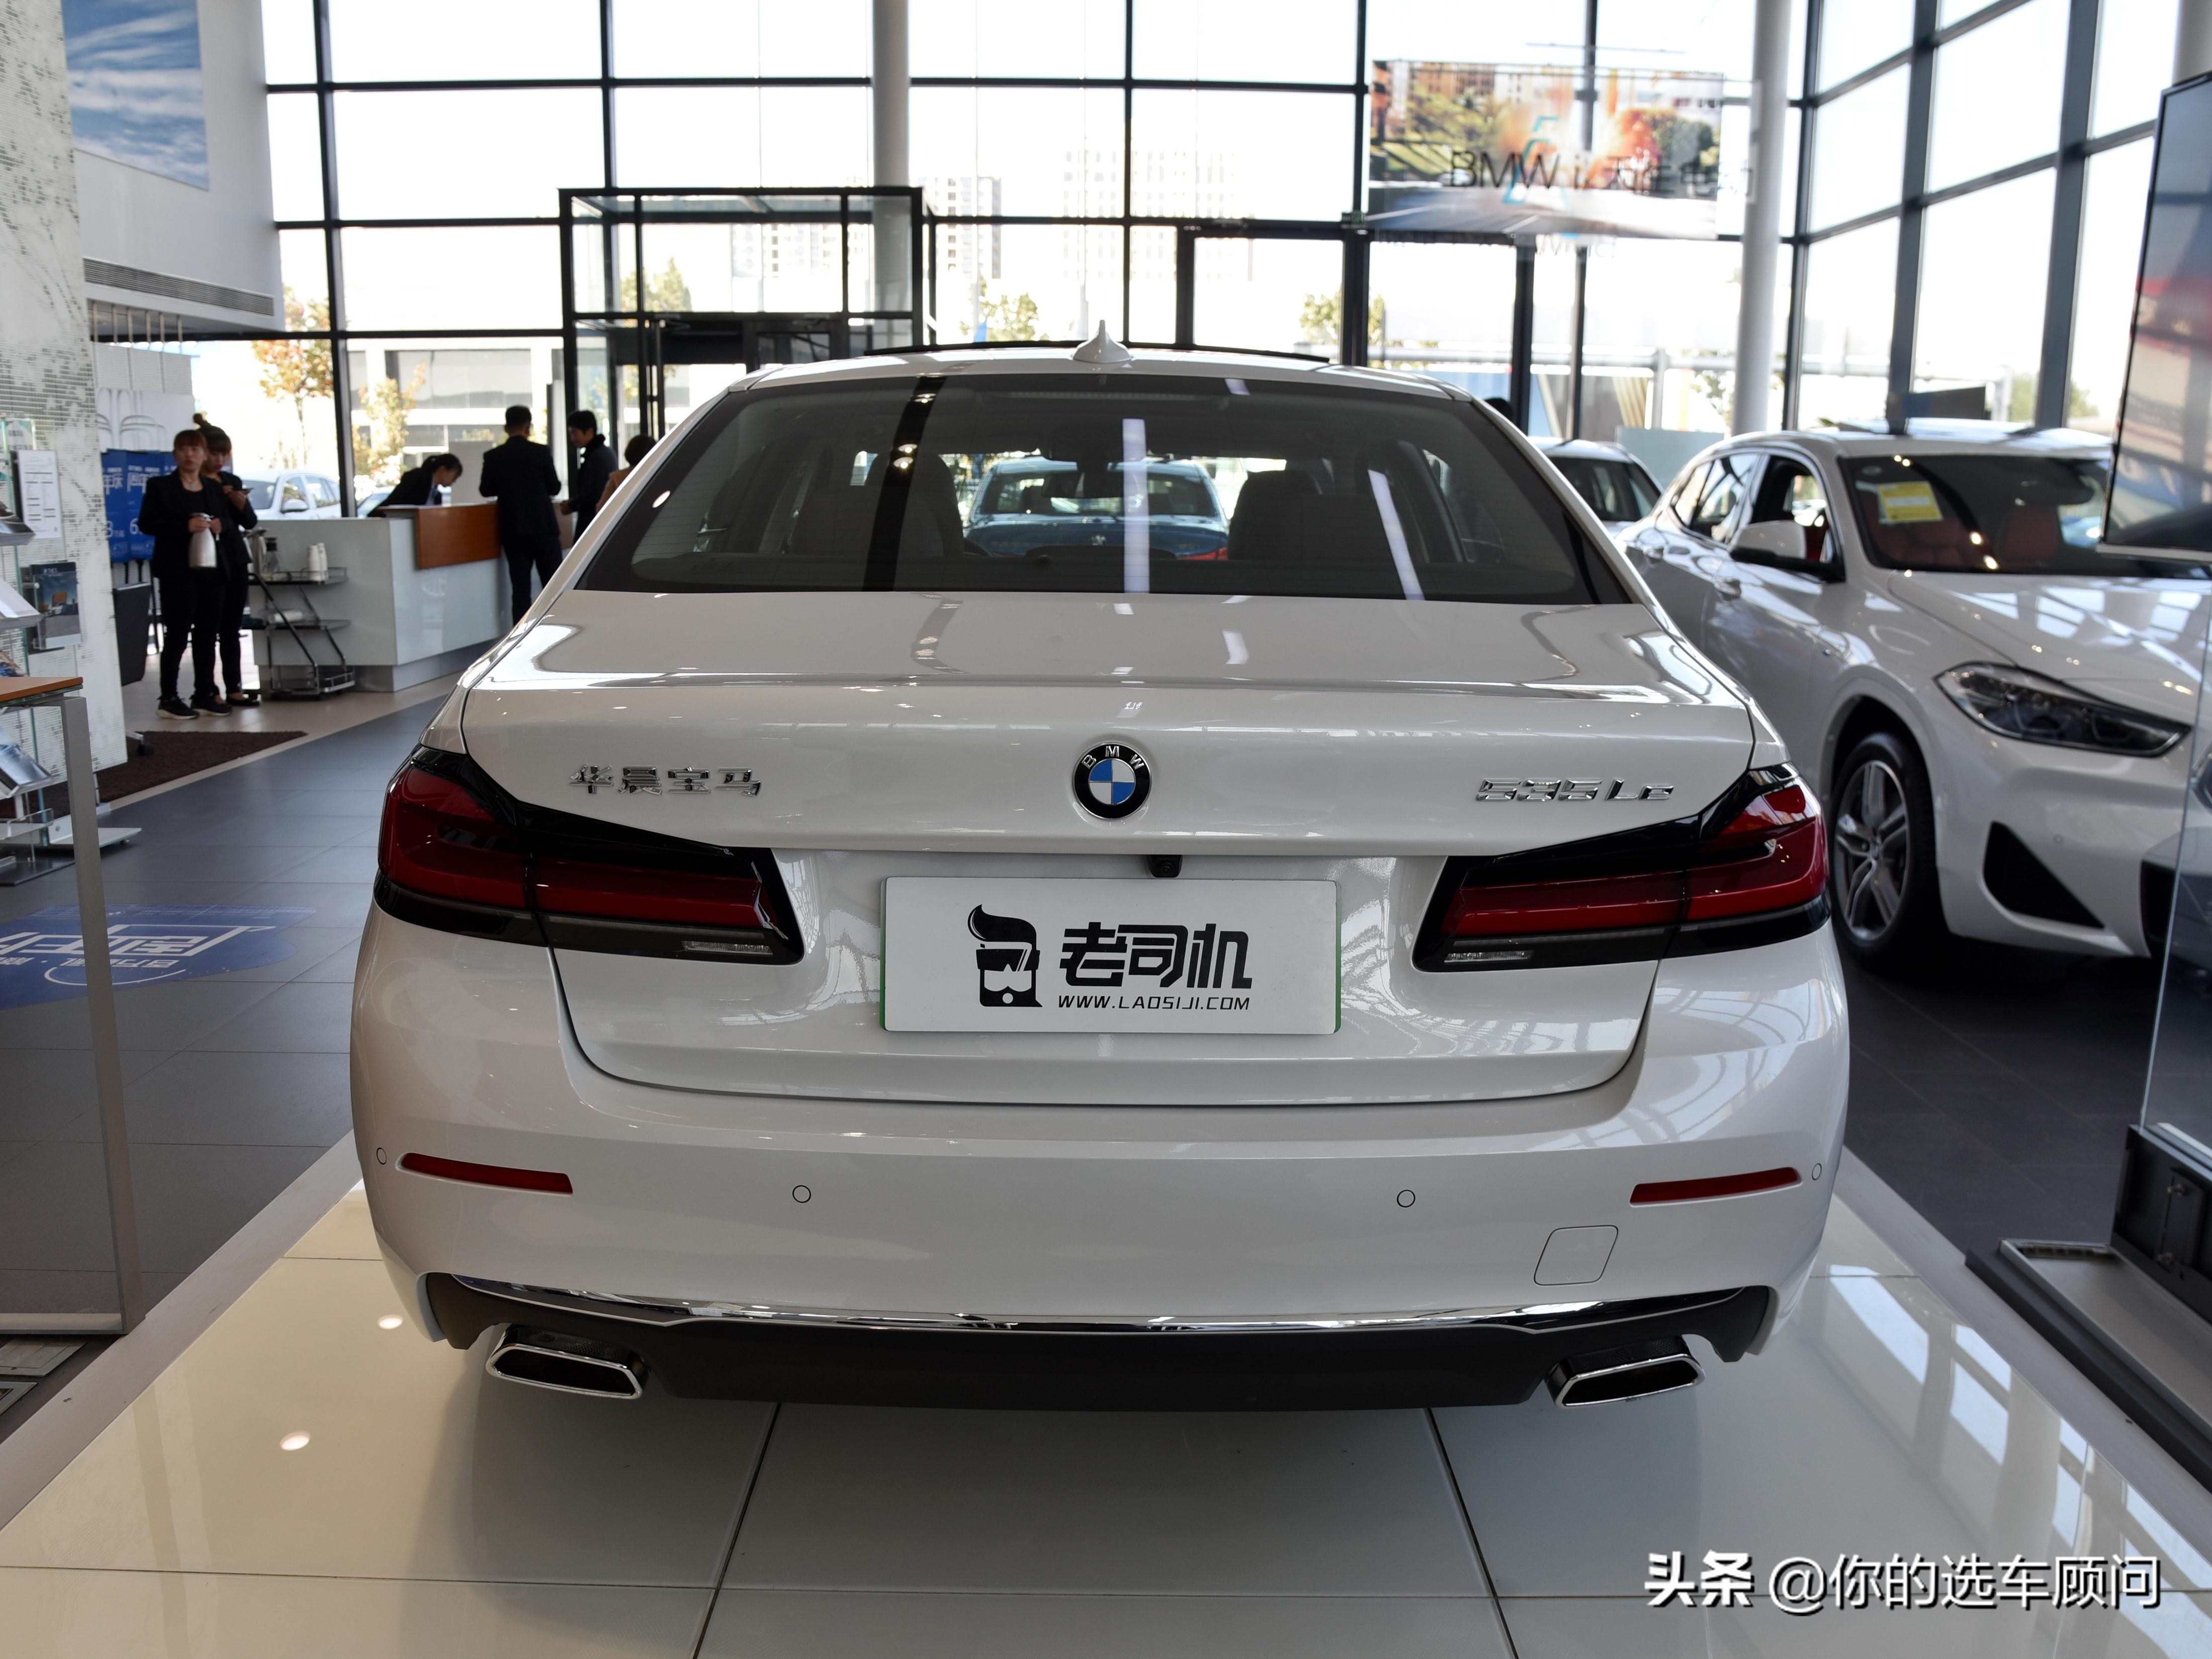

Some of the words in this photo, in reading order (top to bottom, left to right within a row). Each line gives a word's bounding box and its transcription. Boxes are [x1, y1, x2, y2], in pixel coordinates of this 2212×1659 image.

[1451, 150, 1560, 190] BMW
[1081, 746, 1145, 770] BMW
[569, 764, 762, 797] 华晨宝马
[59, 957, 180, 968] 百万礼
[1059, 921, 1253, 990] 老司机
[1058, 995, 1250, 1010] WWW.LAOSIJI.COM
